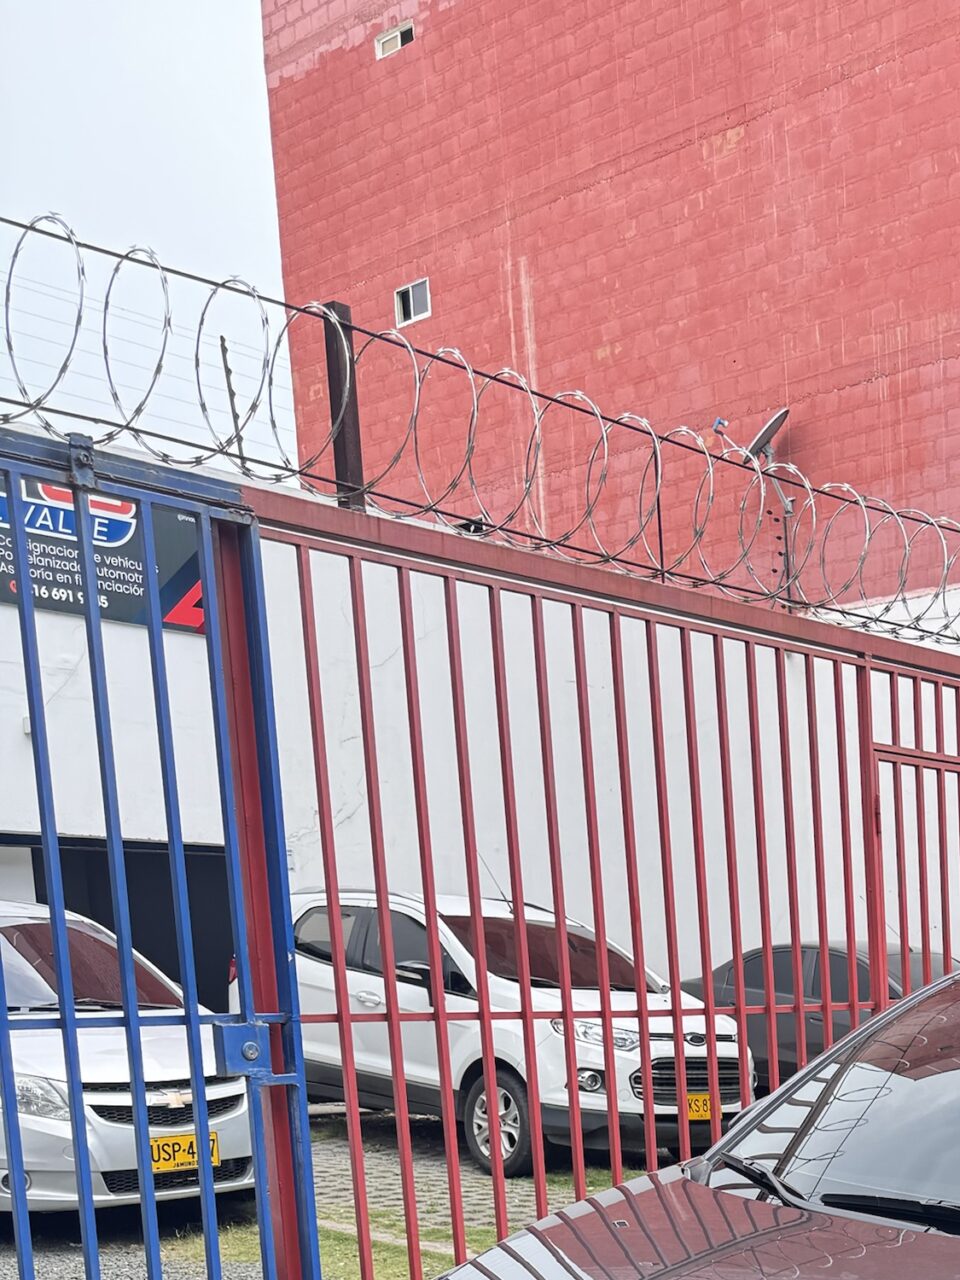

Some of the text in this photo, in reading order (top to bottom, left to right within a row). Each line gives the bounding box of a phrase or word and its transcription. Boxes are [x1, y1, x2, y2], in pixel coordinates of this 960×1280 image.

[24, 504, 109, 541] VALE
[56, 573, 72, 584] en
[31, 584, 49, 599] 16
[51, 587, 74, 603] 691
